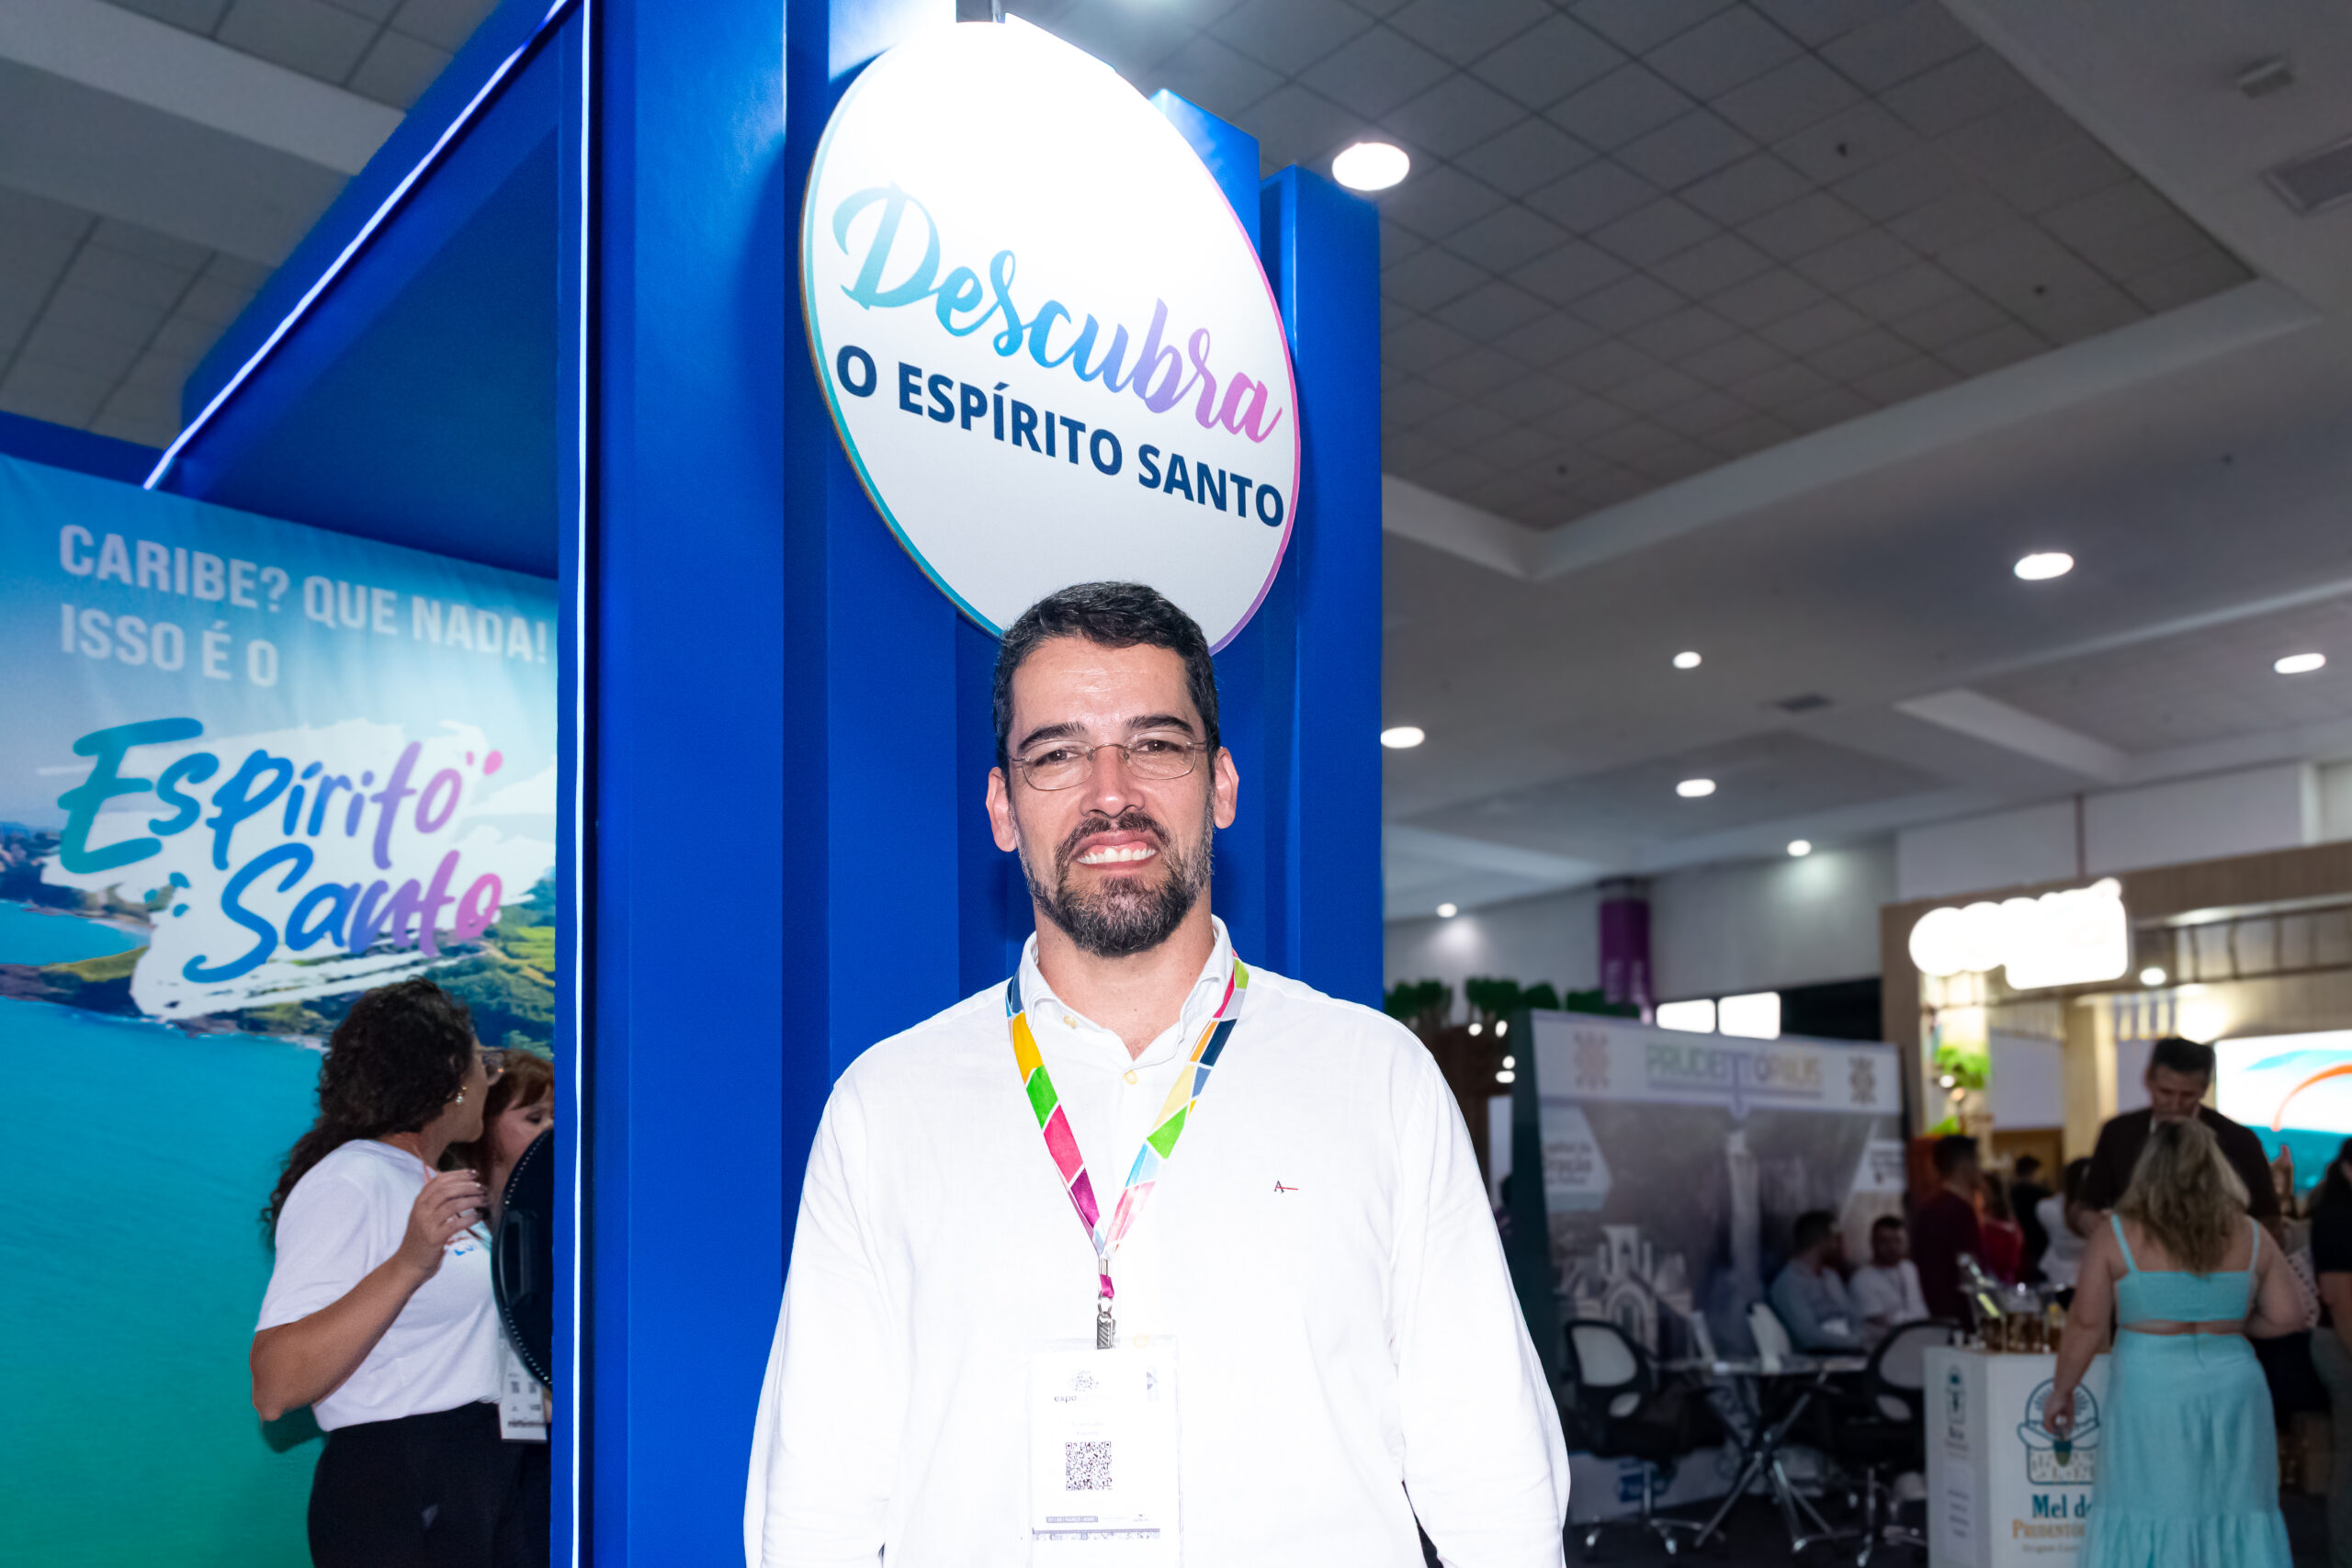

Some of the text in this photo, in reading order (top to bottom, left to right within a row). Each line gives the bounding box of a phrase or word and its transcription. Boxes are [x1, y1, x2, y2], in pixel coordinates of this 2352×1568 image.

[831, 181, 1283, 443] Descubra
[835, 344, 1284, 527] O ESPÍRITO SANTO
[59, 524, 548, 664] CARIBE? QUE NADA!
[61, 604, 278, 688] ISSO É O
[57, 716, 462, 874] Espírito
[183, 841, 503, 984] Santo
[2031, 1494, 2067, 1518] Mel
